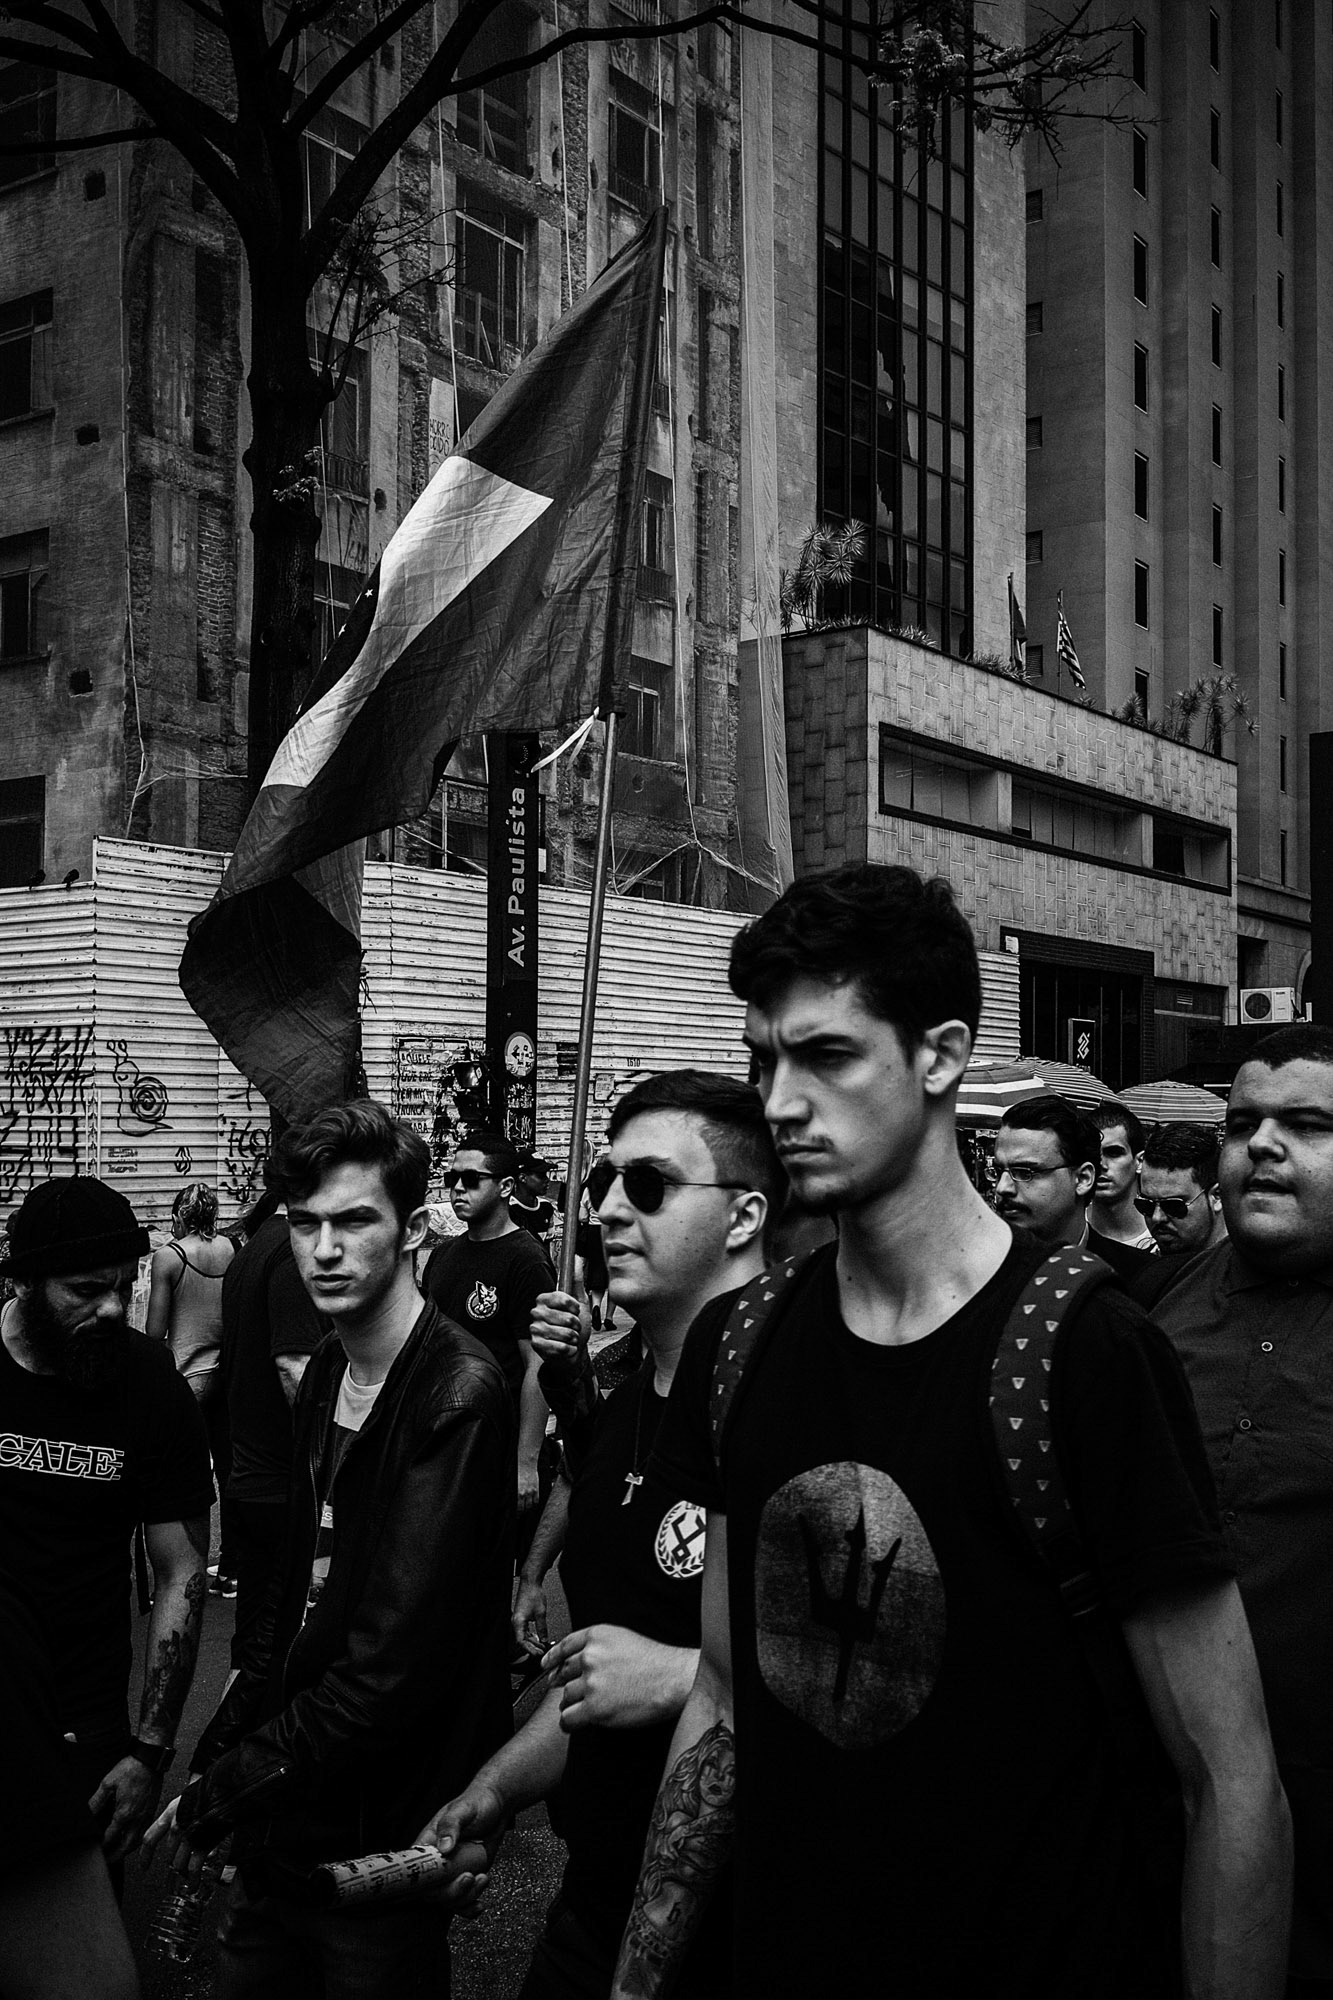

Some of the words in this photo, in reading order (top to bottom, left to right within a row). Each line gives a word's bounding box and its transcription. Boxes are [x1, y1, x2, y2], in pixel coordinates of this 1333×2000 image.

[508, 787, 525, 915] Paulista
[508, 925, 525, 967] Av.
[401, 1104, 425, 1116] NUNCA
